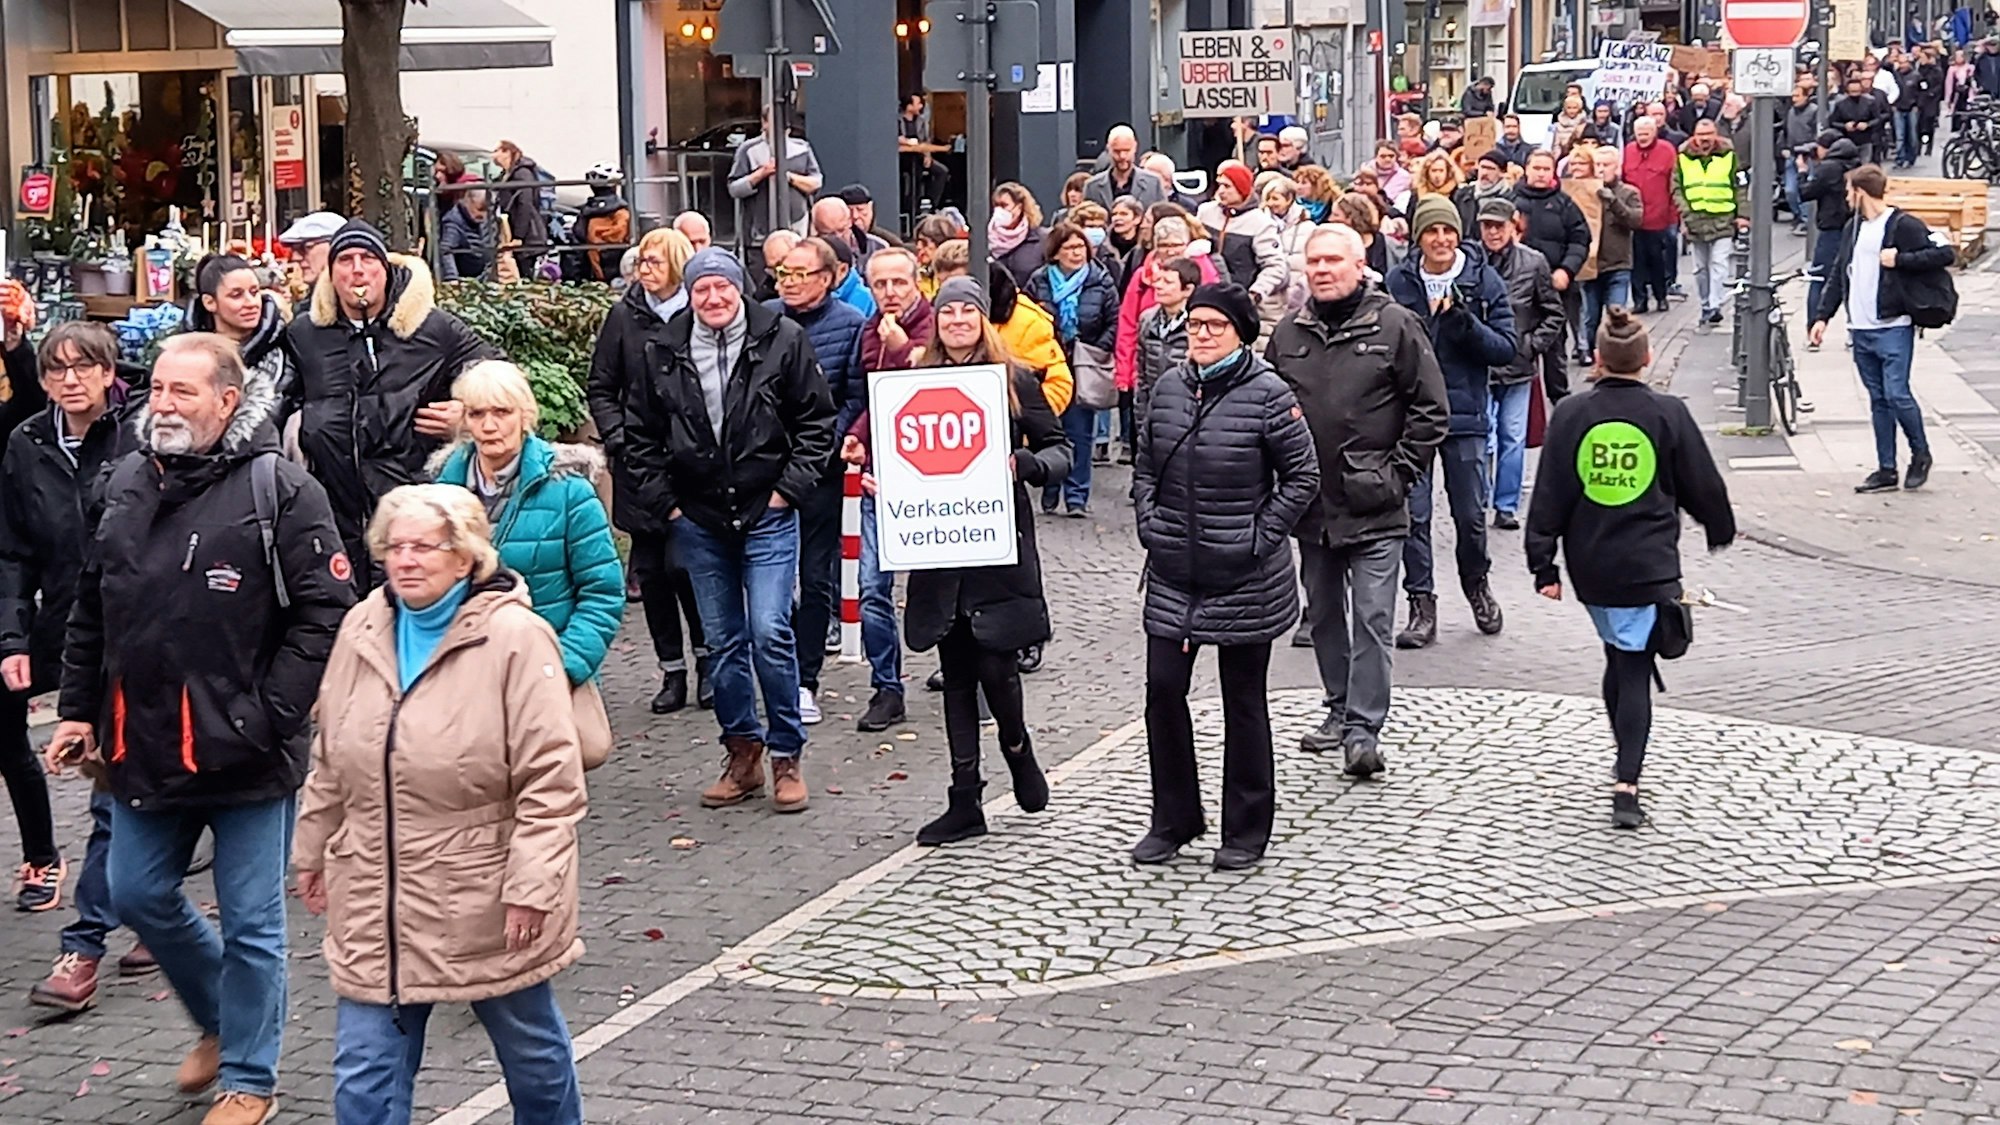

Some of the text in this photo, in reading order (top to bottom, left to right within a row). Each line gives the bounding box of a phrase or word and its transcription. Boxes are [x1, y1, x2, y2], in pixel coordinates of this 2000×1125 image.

[1180, 35, 1270, 59] LEBEN &
[1181, 60, 1292, 84] ÜBERLEBEN
[1182, 86, 1257, 109] LASSEN
[900, 411, 981, 453] STOP
[1589, 472, 1637, 488] Markt
[887, 498, 1004, 519] Verkacken
[899, 525, 996, 546] verboten
